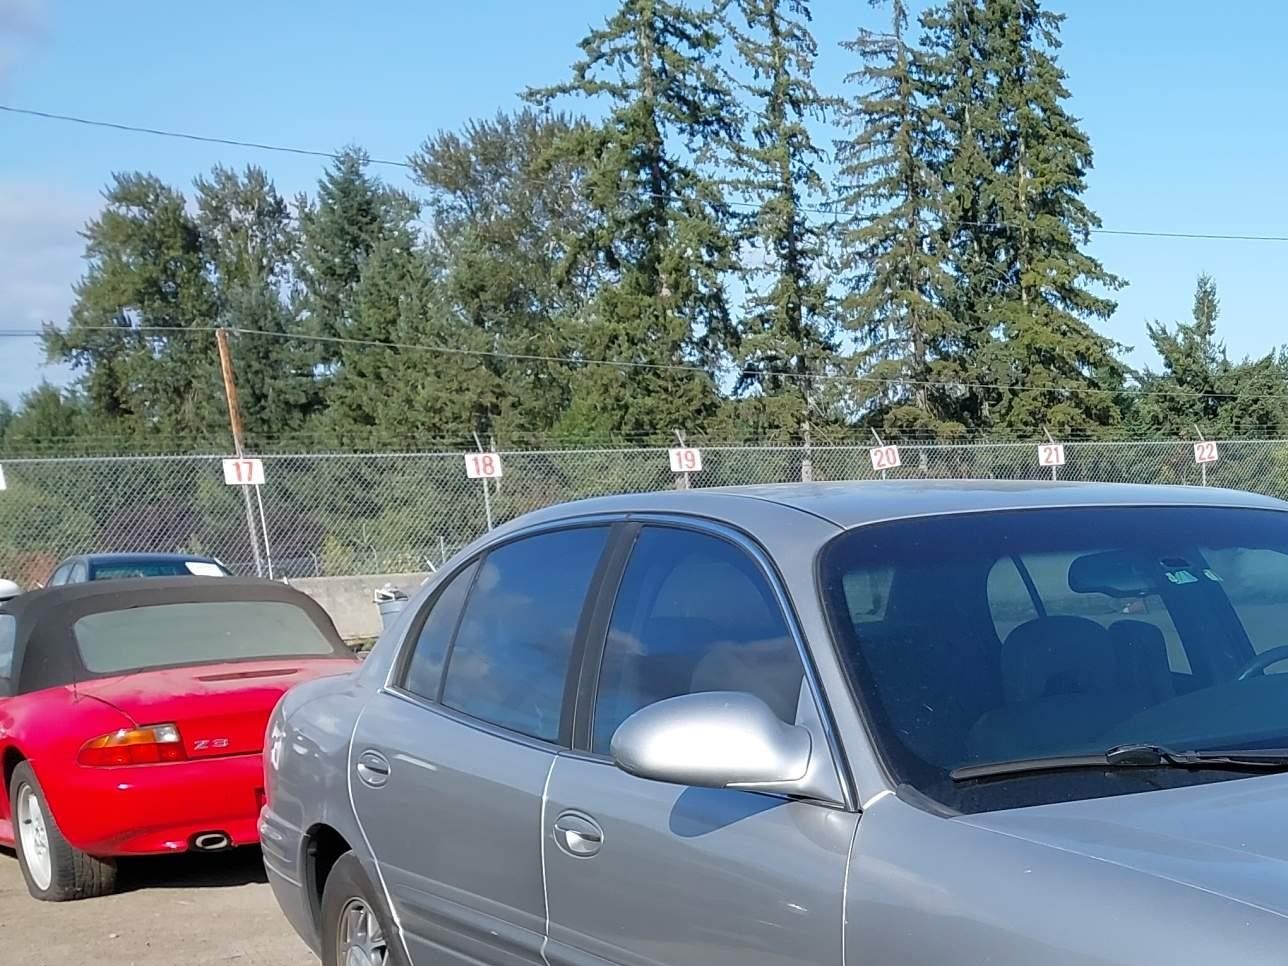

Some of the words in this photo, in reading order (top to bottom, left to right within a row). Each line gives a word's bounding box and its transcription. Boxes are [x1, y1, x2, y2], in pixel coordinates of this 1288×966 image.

[676, 450, 696, 469] 19
[874, 447, 897, 468] 20
[1043, 449, 1059, 464] 21
[1196, 443, 1215, 461] 22
[232, 462, 253, 481] 17
[472, 455, 495, 475] 18
[193, 738, 229, 751] Z3
